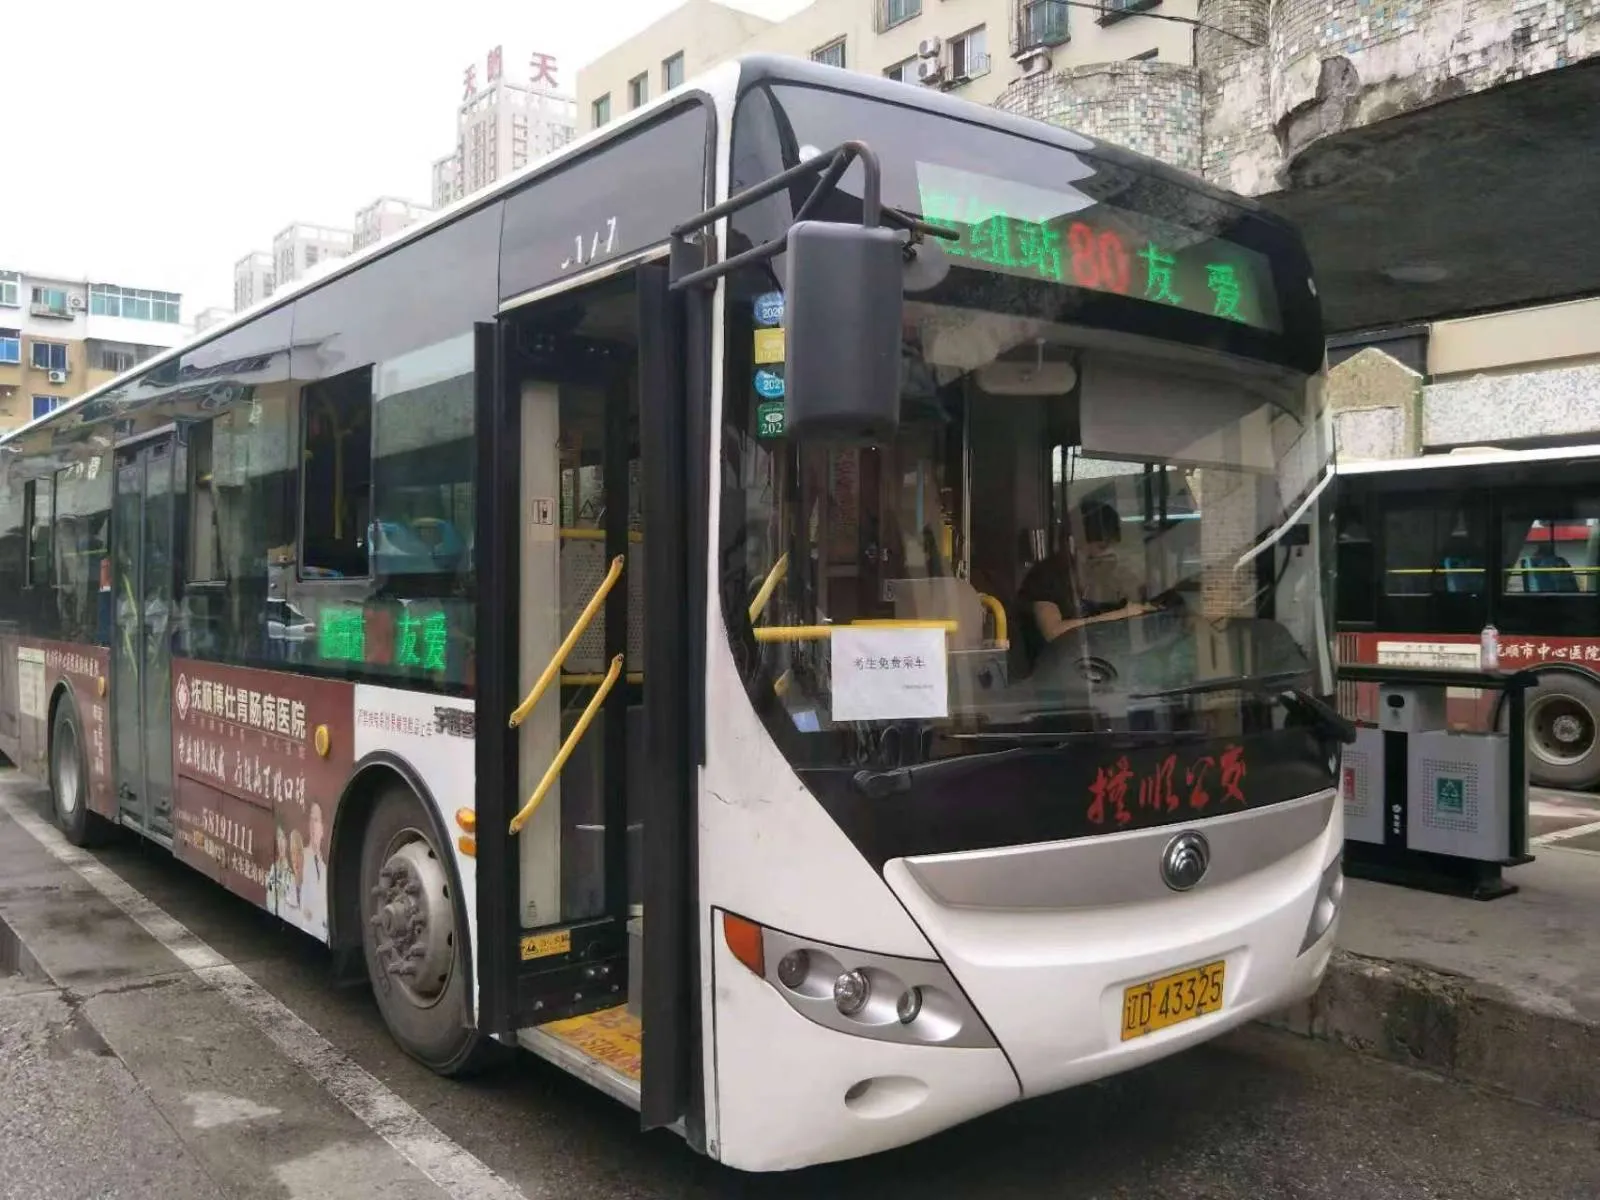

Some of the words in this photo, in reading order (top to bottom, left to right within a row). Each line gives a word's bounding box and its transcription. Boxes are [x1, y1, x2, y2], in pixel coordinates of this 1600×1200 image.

[1068, 223, 1132, 293] 80
[761, 423, 783, 434] 202
[191, 677, 306, 739] 抚顺博仕胃肠病医院
[202, 807, 253, 855] 58191111
